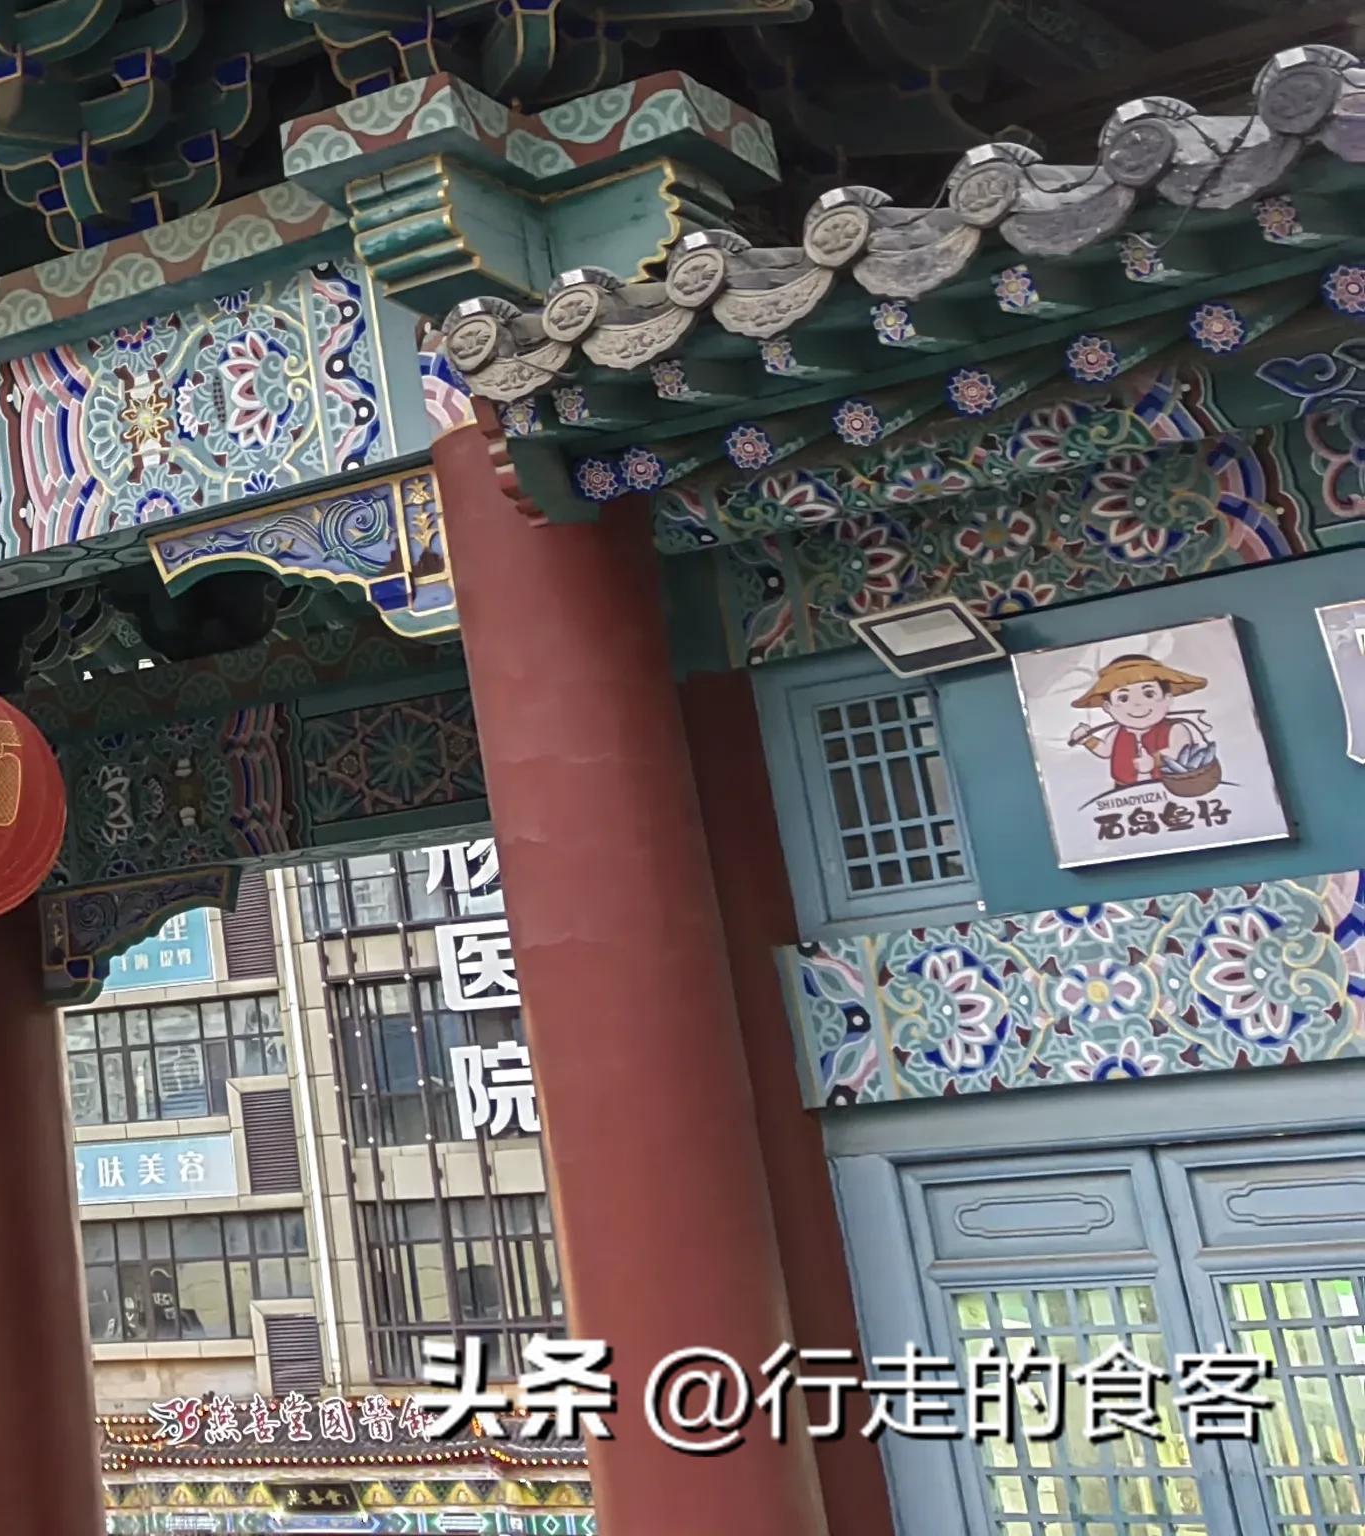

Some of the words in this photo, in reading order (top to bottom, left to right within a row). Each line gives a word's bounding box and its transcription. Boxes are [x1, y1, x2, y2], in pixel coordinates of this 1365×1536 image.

[1096, 791, 1168, 811] SHIDAOYUZAI
[1094, 799, 1232, 841] 石岛鱼仔
